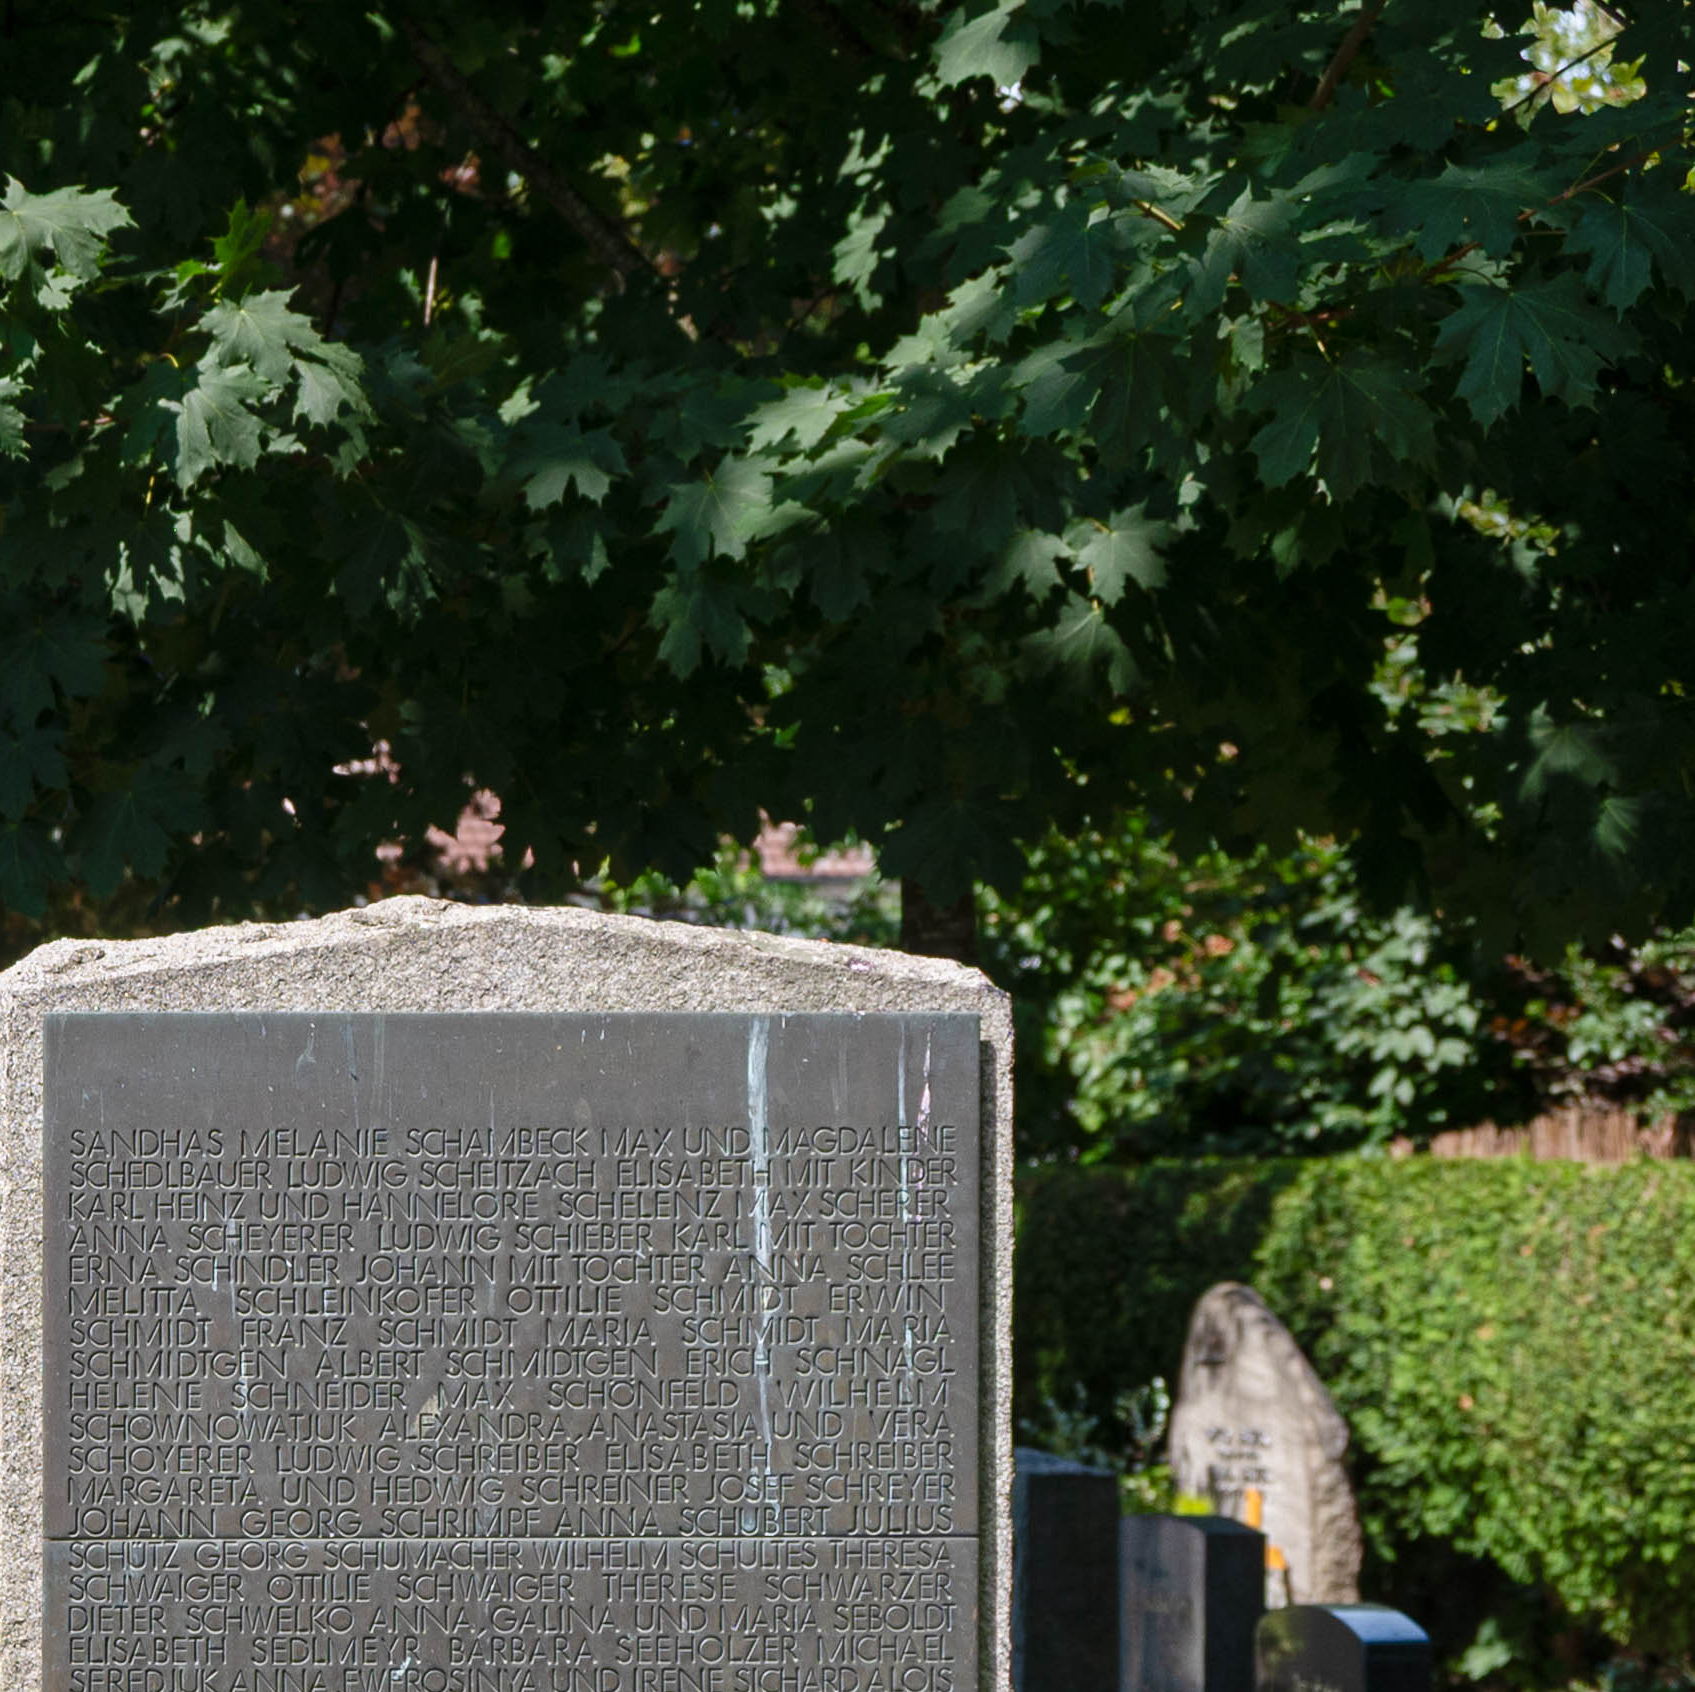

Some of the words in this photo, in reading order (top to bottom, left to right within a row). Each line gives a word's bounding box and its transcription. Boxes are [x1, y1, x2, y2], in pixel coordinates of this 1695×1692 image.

[69, 1128, 225, 1159] SANDHAS
[239, 1127, 389, 1158] MELANIE
[405, 1127, 589, 1158] SCHAMBECK
[600, 1126, 674, 1158] MAX
[682, 1126, 751, 1157] UND
[763, 1126, 958, 1157] MAGDALENE
[67, 1287, 202, 1317] MELITTA
[234, 1286, 478, 1316] SCHLEINKOFER
[506, 1286, 623, 1316] OTTILIE
[653, 1285, 799, 1315] SCHMIDT
[828, 1285, 946, 1315] ERWIN
[69, 1349, 288, 1379] SCHMIDTGEN
[314, 1349, 426, 1379] ALBERT
[445, 1348, 659, 1378] SCHMIDTGEN
[685, 1348, 772, 1378] ERICH
[795, 1347, 957, 1377] SCHNAGL
[68, 1381, 203, 1411] HELENE
[229, 1381, 408, 1411] SCHNEIDER
[437, 1380, 516, 1410] MAX
[547, 1380, 740, 1410] SCHÖNFELD
[776, 1379, 948, 1410] WILHELM
[68, 1573, 246, 1603] SCHWAIGER
[395, 1573, 576, 1603] SCHWAIGER
[602, 1572, 738, 1603] THERESE
[763, 1572, 953, 1603] SCHWARZER
[68, 1635, 228, 1666] ELISABETH
[449, 1635, 599, 1666] BARBARA
[615, 1635, 800, 1666] SEEHOLZER
[816, 1635, 955, 1665] MICHAEL
